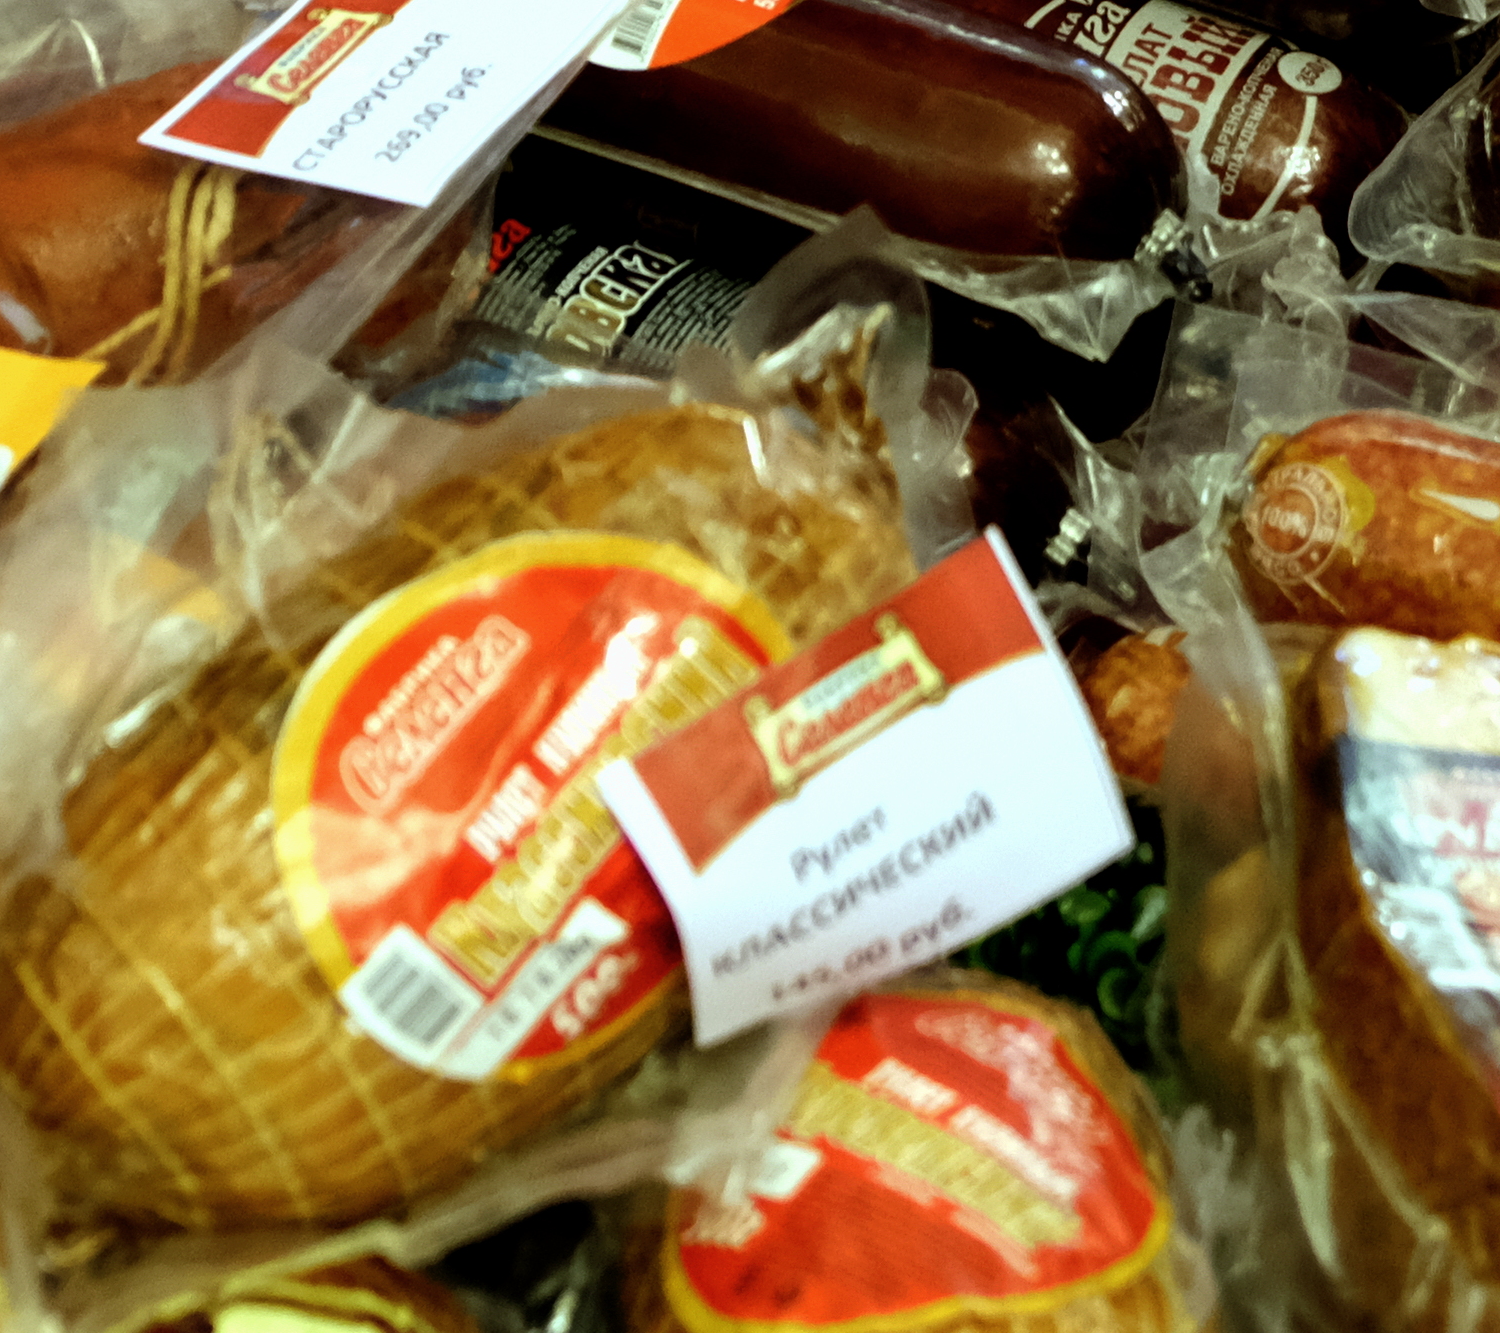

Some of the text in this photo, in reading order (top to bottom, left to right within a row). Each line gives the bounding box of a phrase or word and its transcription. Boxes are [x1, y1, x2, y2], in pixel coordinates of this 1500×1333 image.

[291, 31, 452, 174] СТАРОРУССКАЯ
[709, 789, 999, 983] КЛАССИЧЕСКИЙ
[789, 807, 889, 885] Рулет
